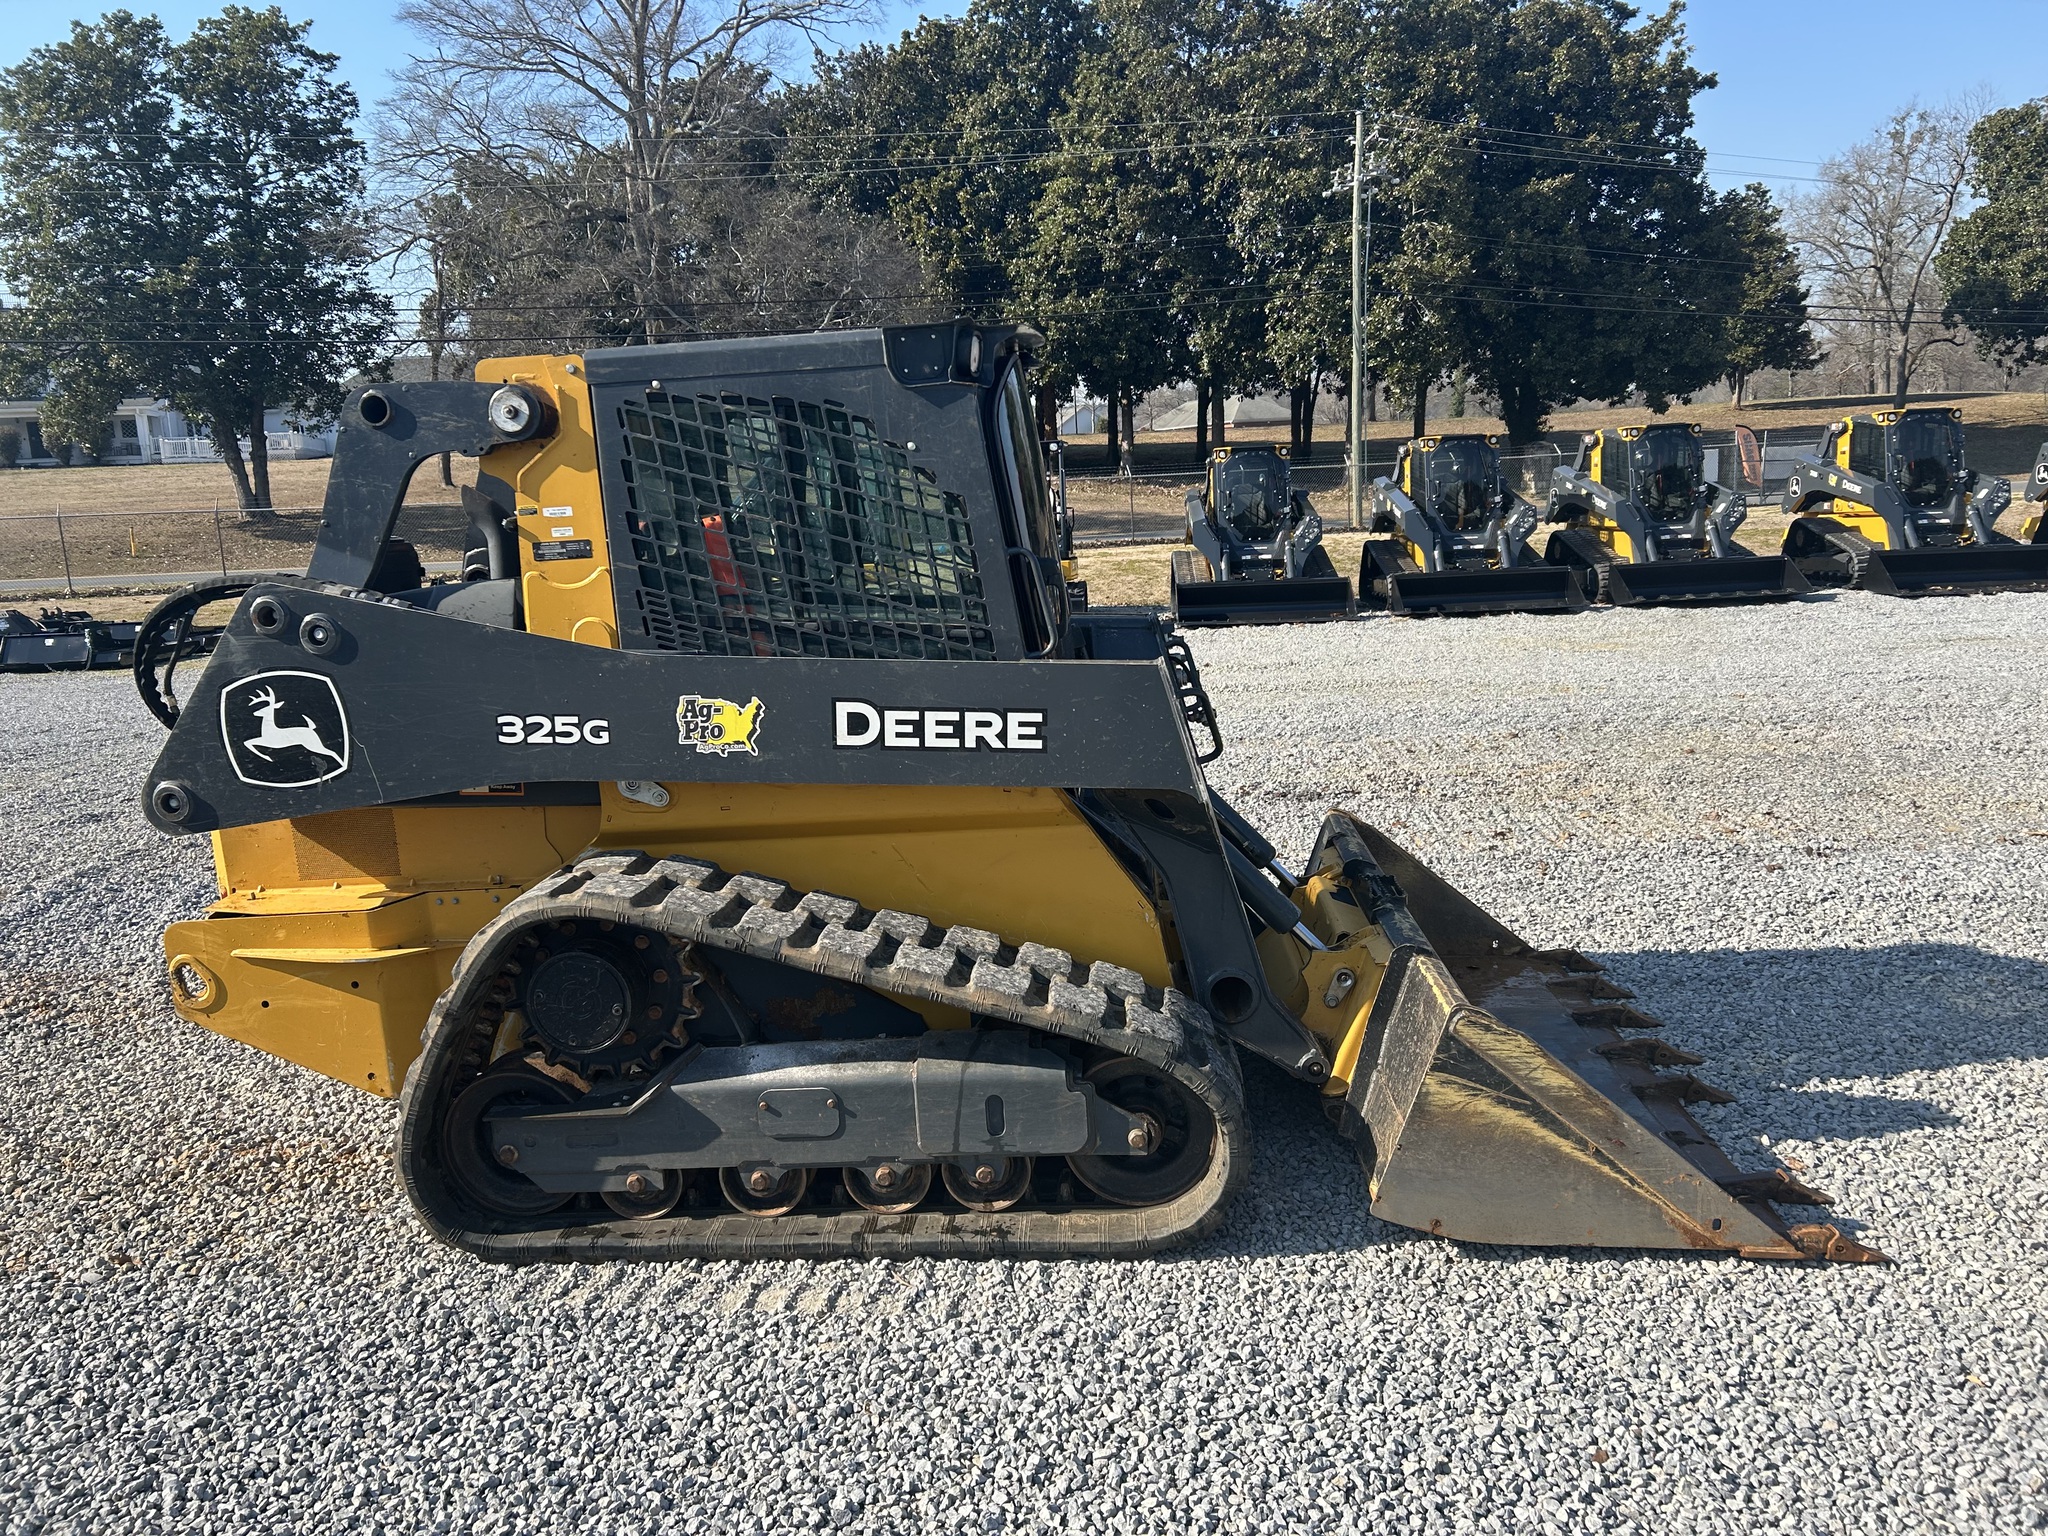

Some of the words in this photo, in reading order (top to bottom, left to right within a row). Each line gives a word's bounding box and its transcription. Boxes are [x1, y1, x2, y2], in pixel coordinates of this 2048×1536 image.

[680, 699, 721, 722] Ag-
[497, 715, 610, 745] 325G
[682, 721, 723, 741] Pro
[836, 702, 1043, 749] DEERE
